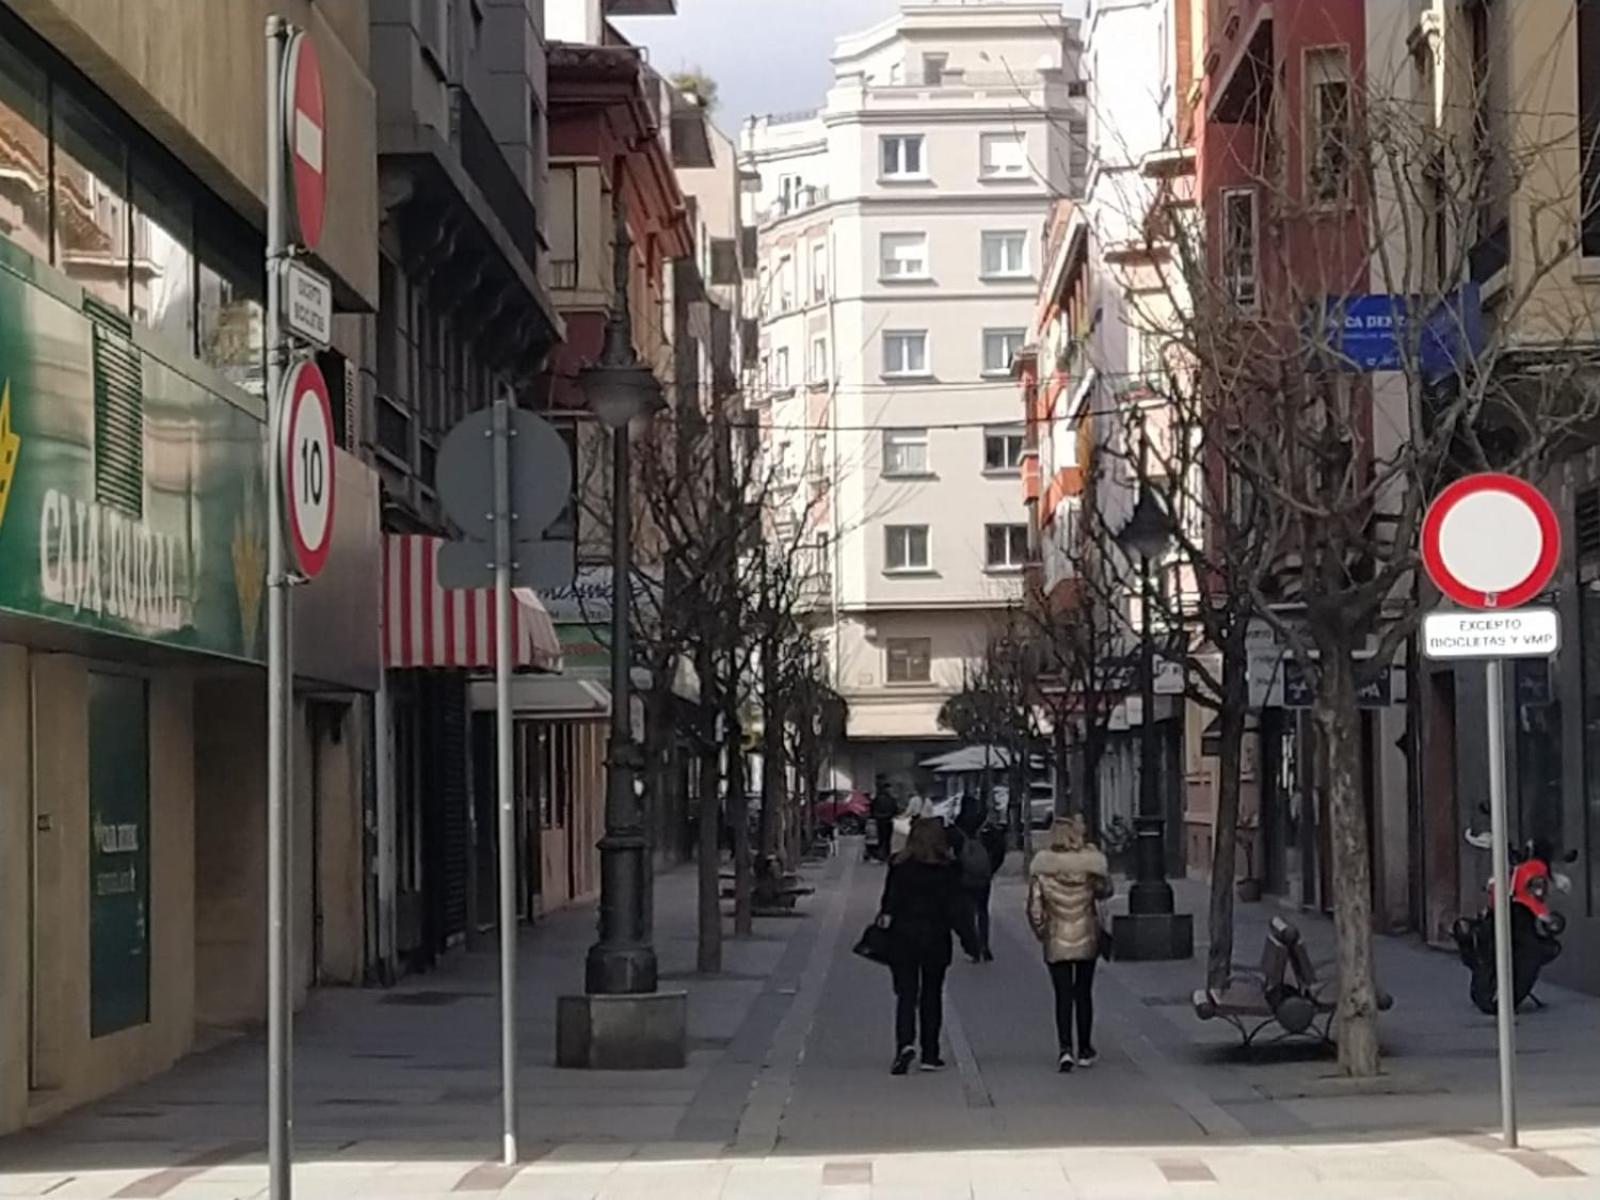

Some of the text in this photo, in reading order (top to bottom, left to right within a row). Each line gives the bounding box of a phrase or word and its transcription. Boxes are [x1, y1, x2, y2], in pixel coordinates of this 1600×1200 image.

[302, 437, 323, 506] 10
[40, 488, 102, 619] CAJA
[1430, 633, 1553, 649] BICICLETAS Y VMP
[1459, 618, 1522, 632] EXCEPTO
